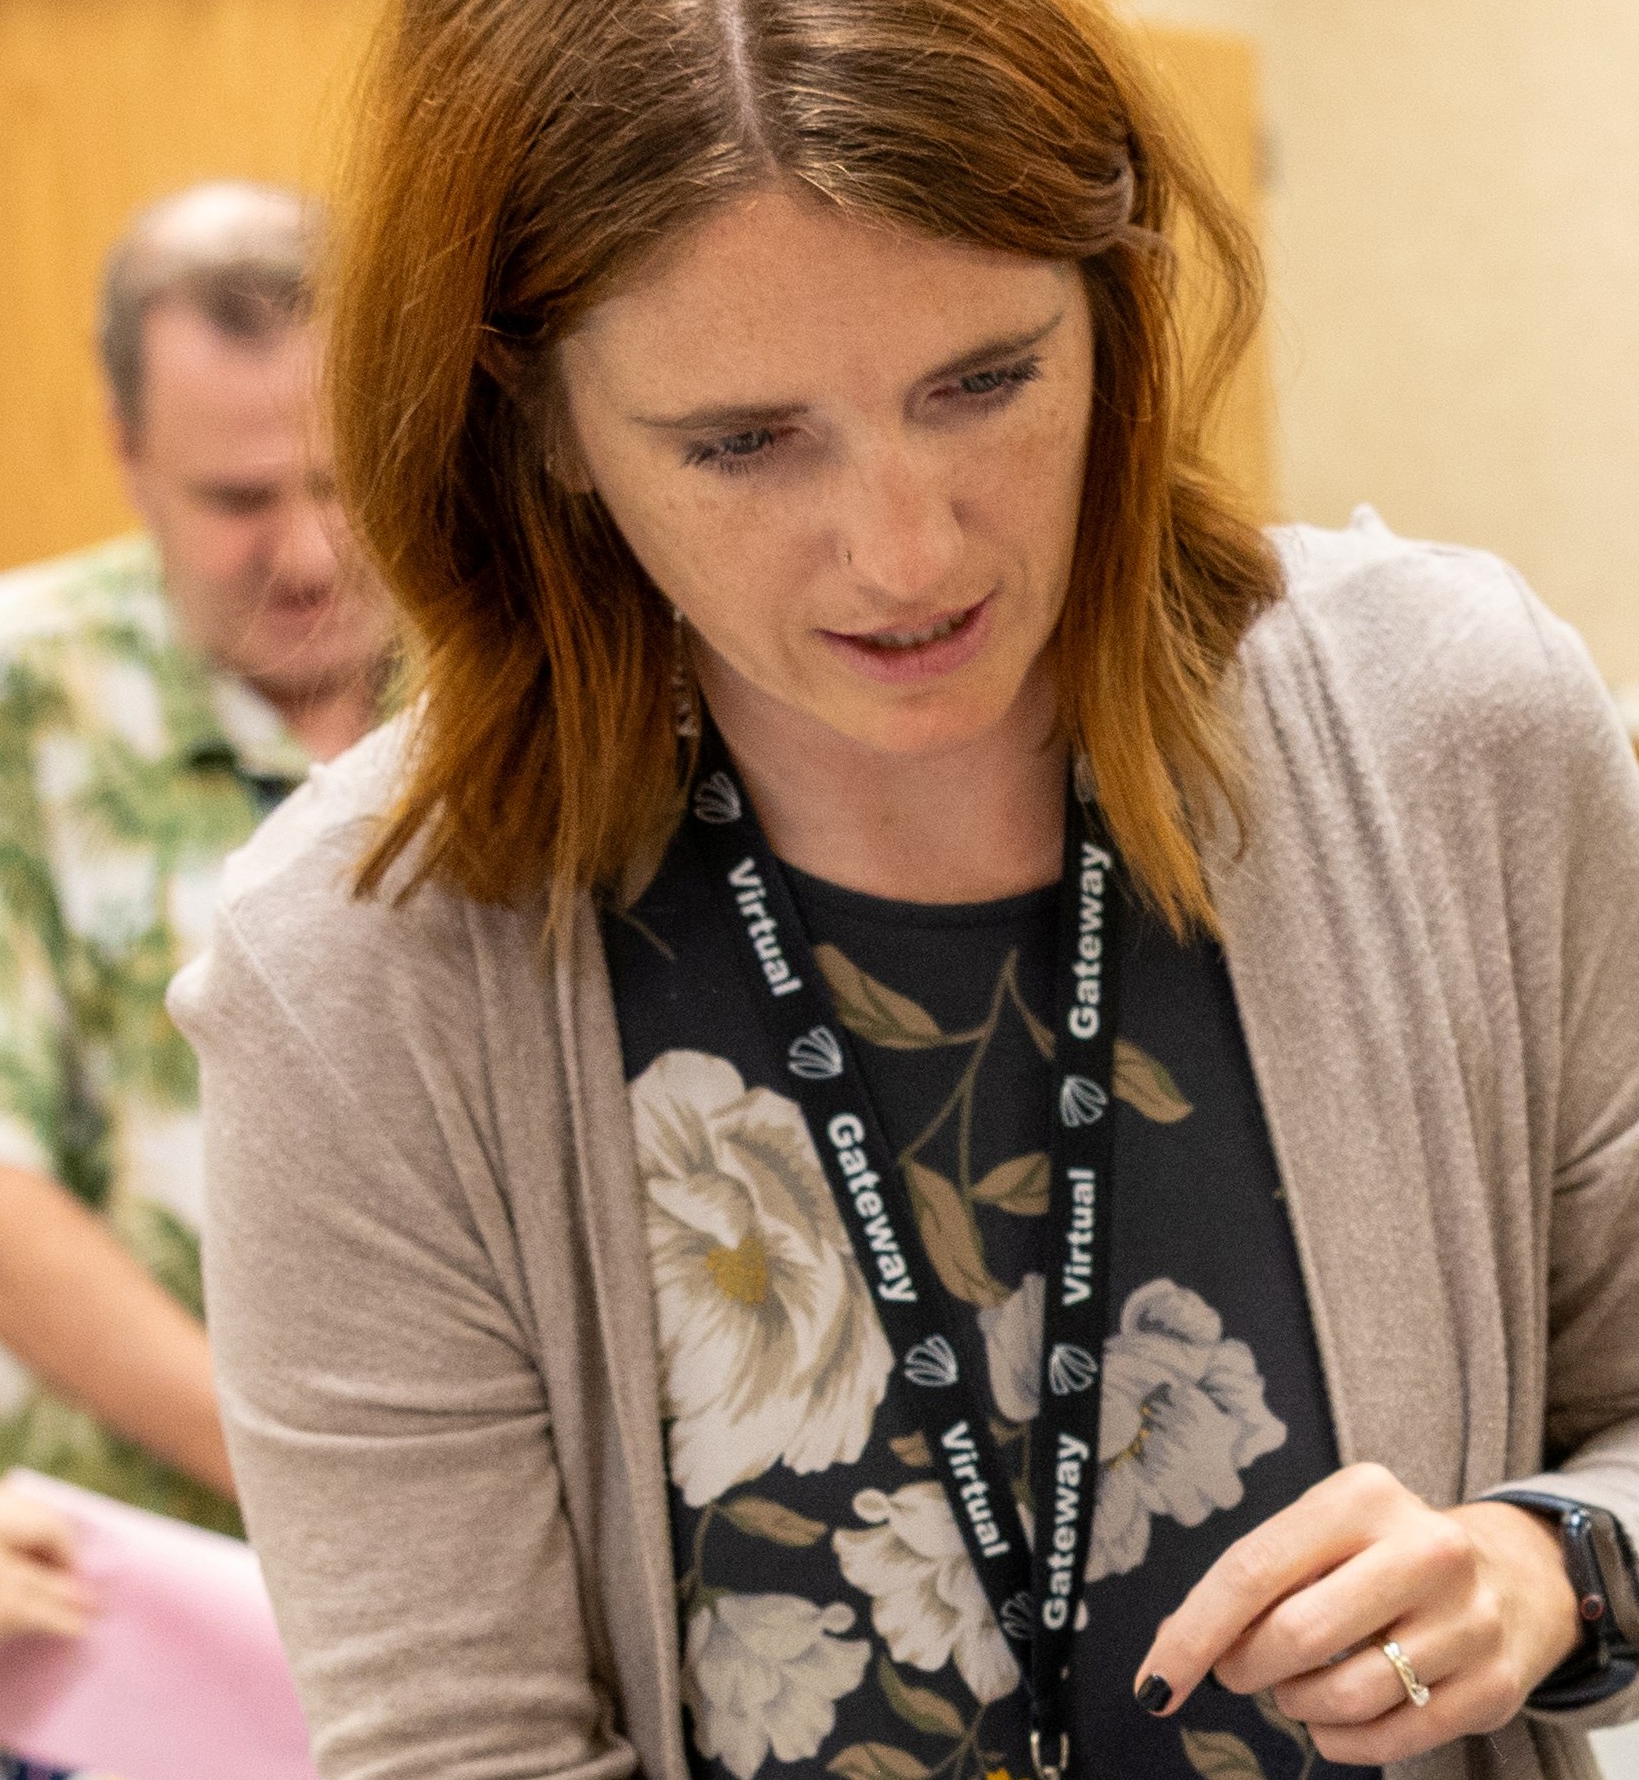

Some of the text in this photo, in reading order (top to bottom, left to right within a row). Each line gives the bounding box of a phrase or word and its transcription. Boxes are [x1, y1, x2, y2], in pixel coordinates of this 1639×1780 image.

[727, 857, 1011, 1559] Virtual Gateway Virtual
[1042, 841, 1113, 1631] Gateway Virtual Gateway
